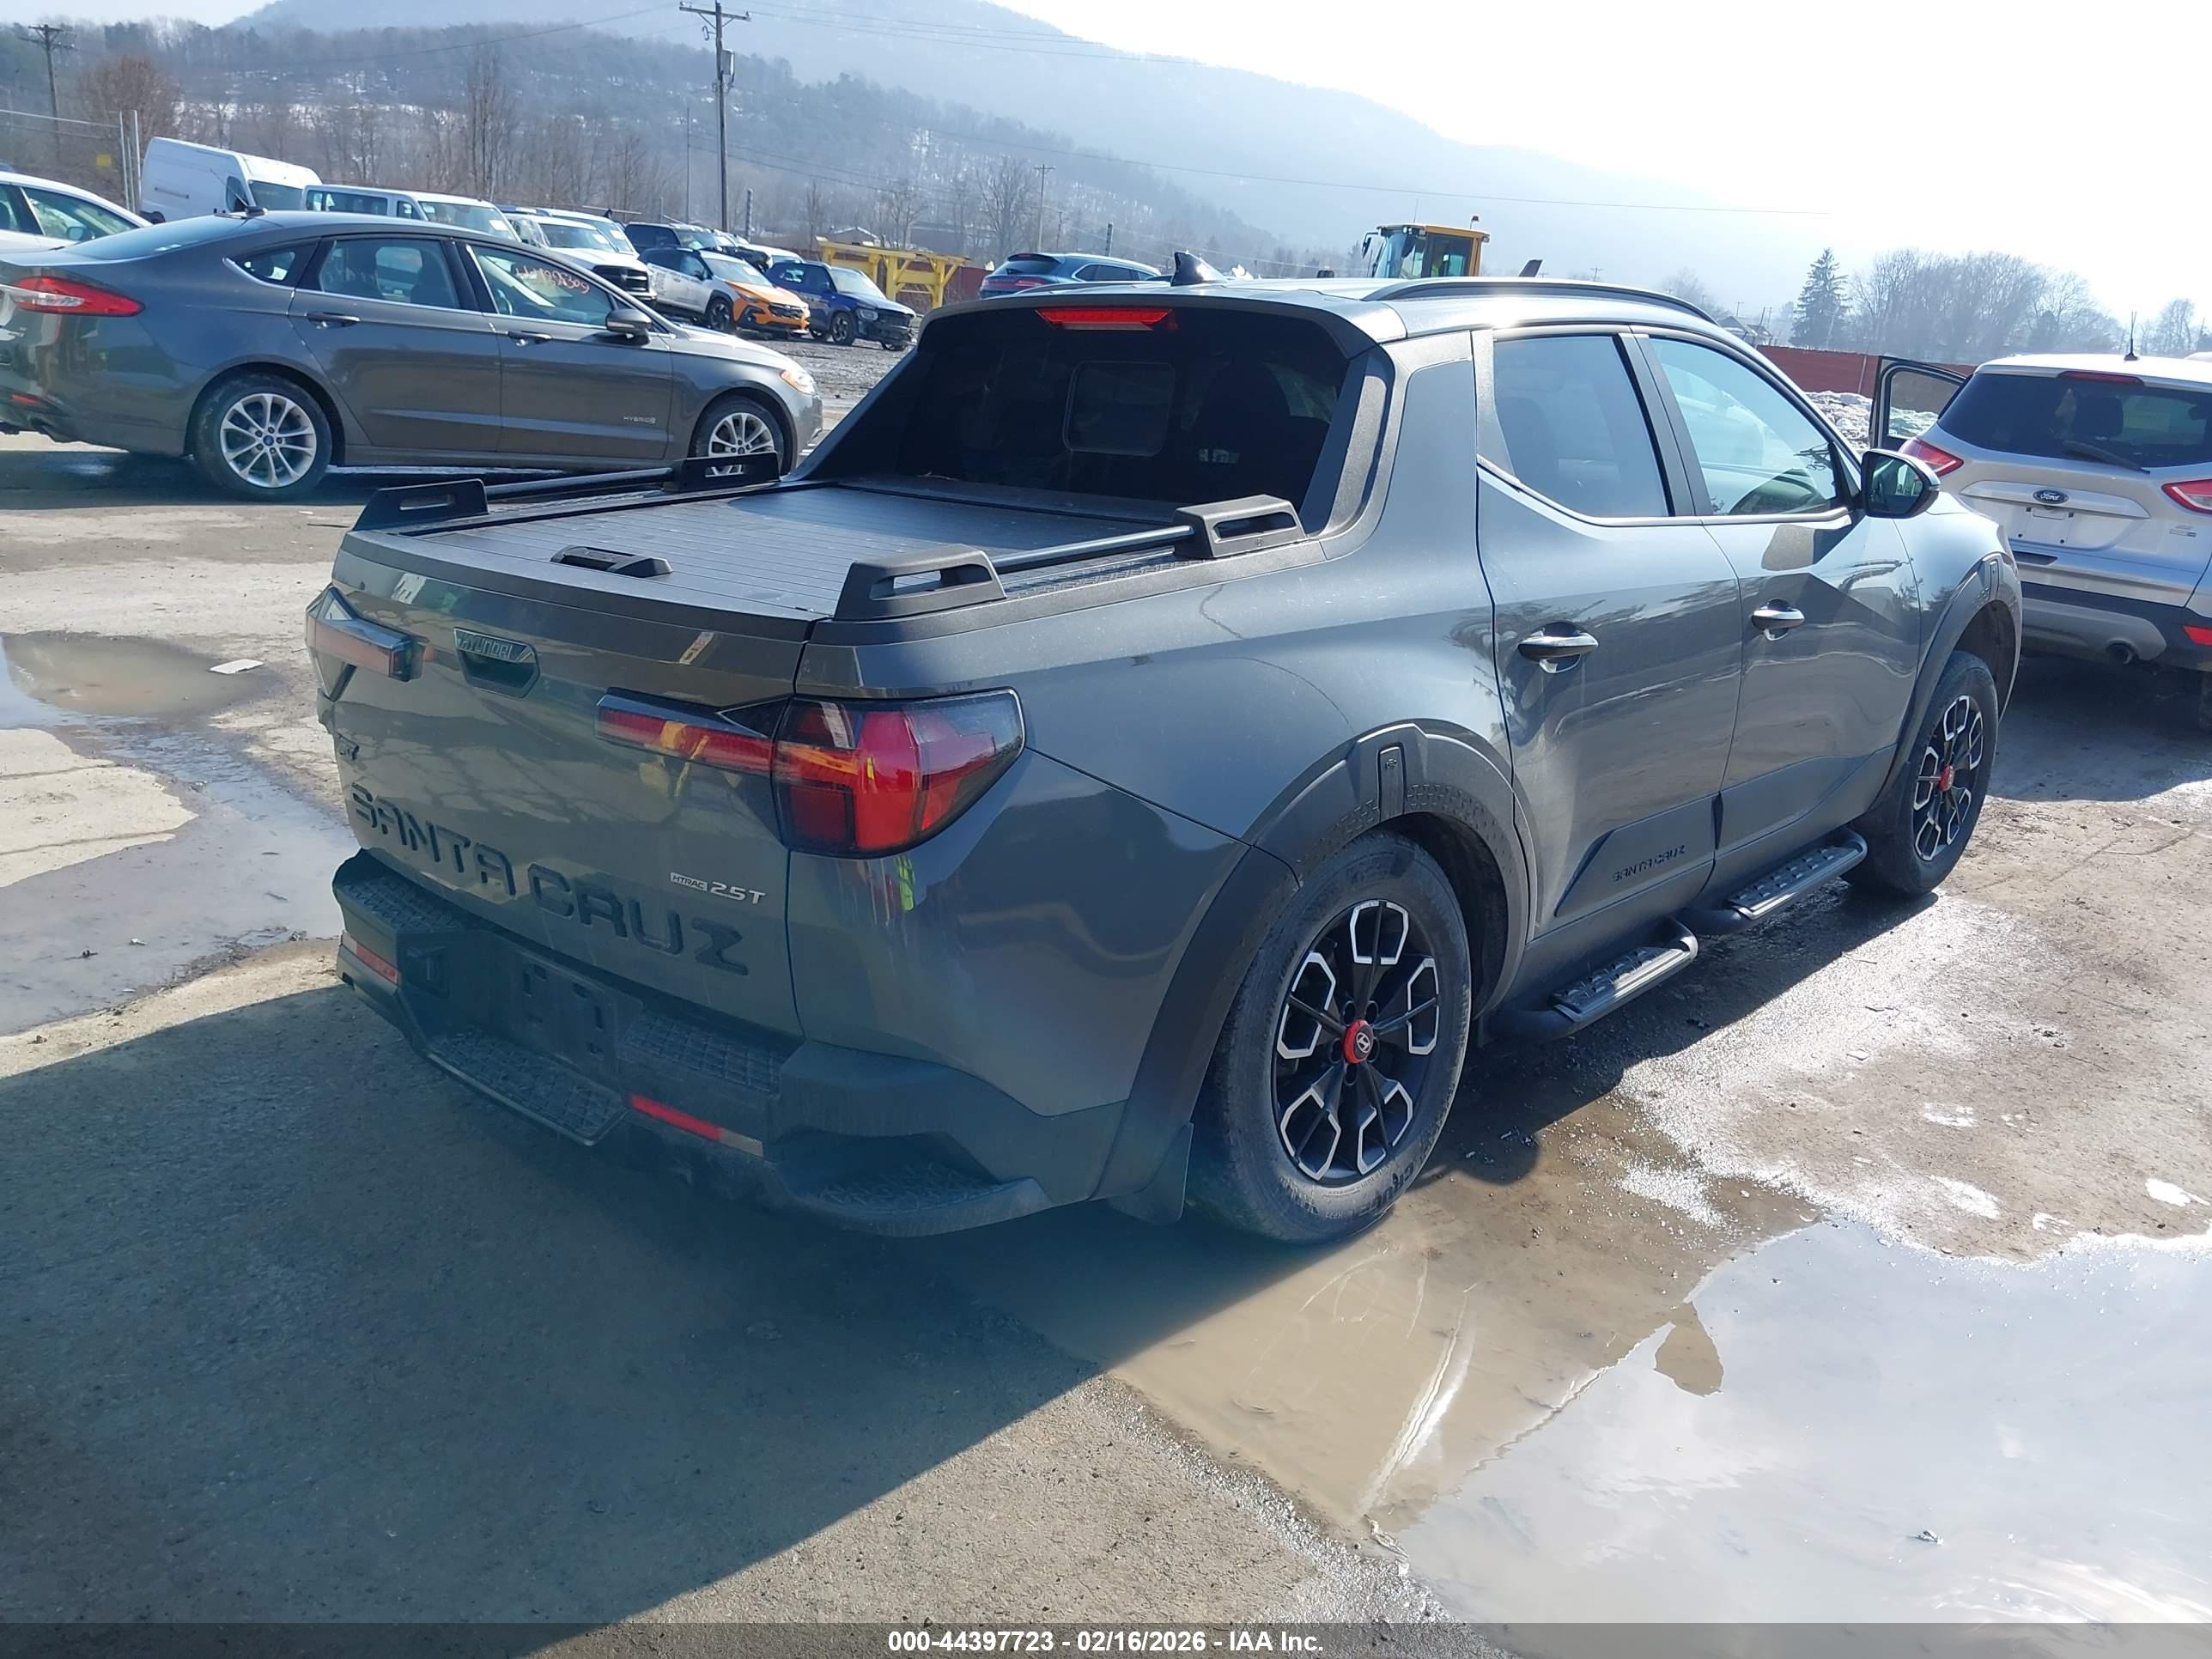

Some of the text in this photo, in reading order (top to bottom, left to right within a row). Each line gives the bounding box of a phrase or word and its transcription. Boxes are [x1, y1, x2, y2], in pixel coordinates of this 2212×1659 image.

[350, 782, 750, 976] SANTA CRUZ
[671, 873, 707, 891] HTRAC
[1613, 858, 1653, 882] SANTA
